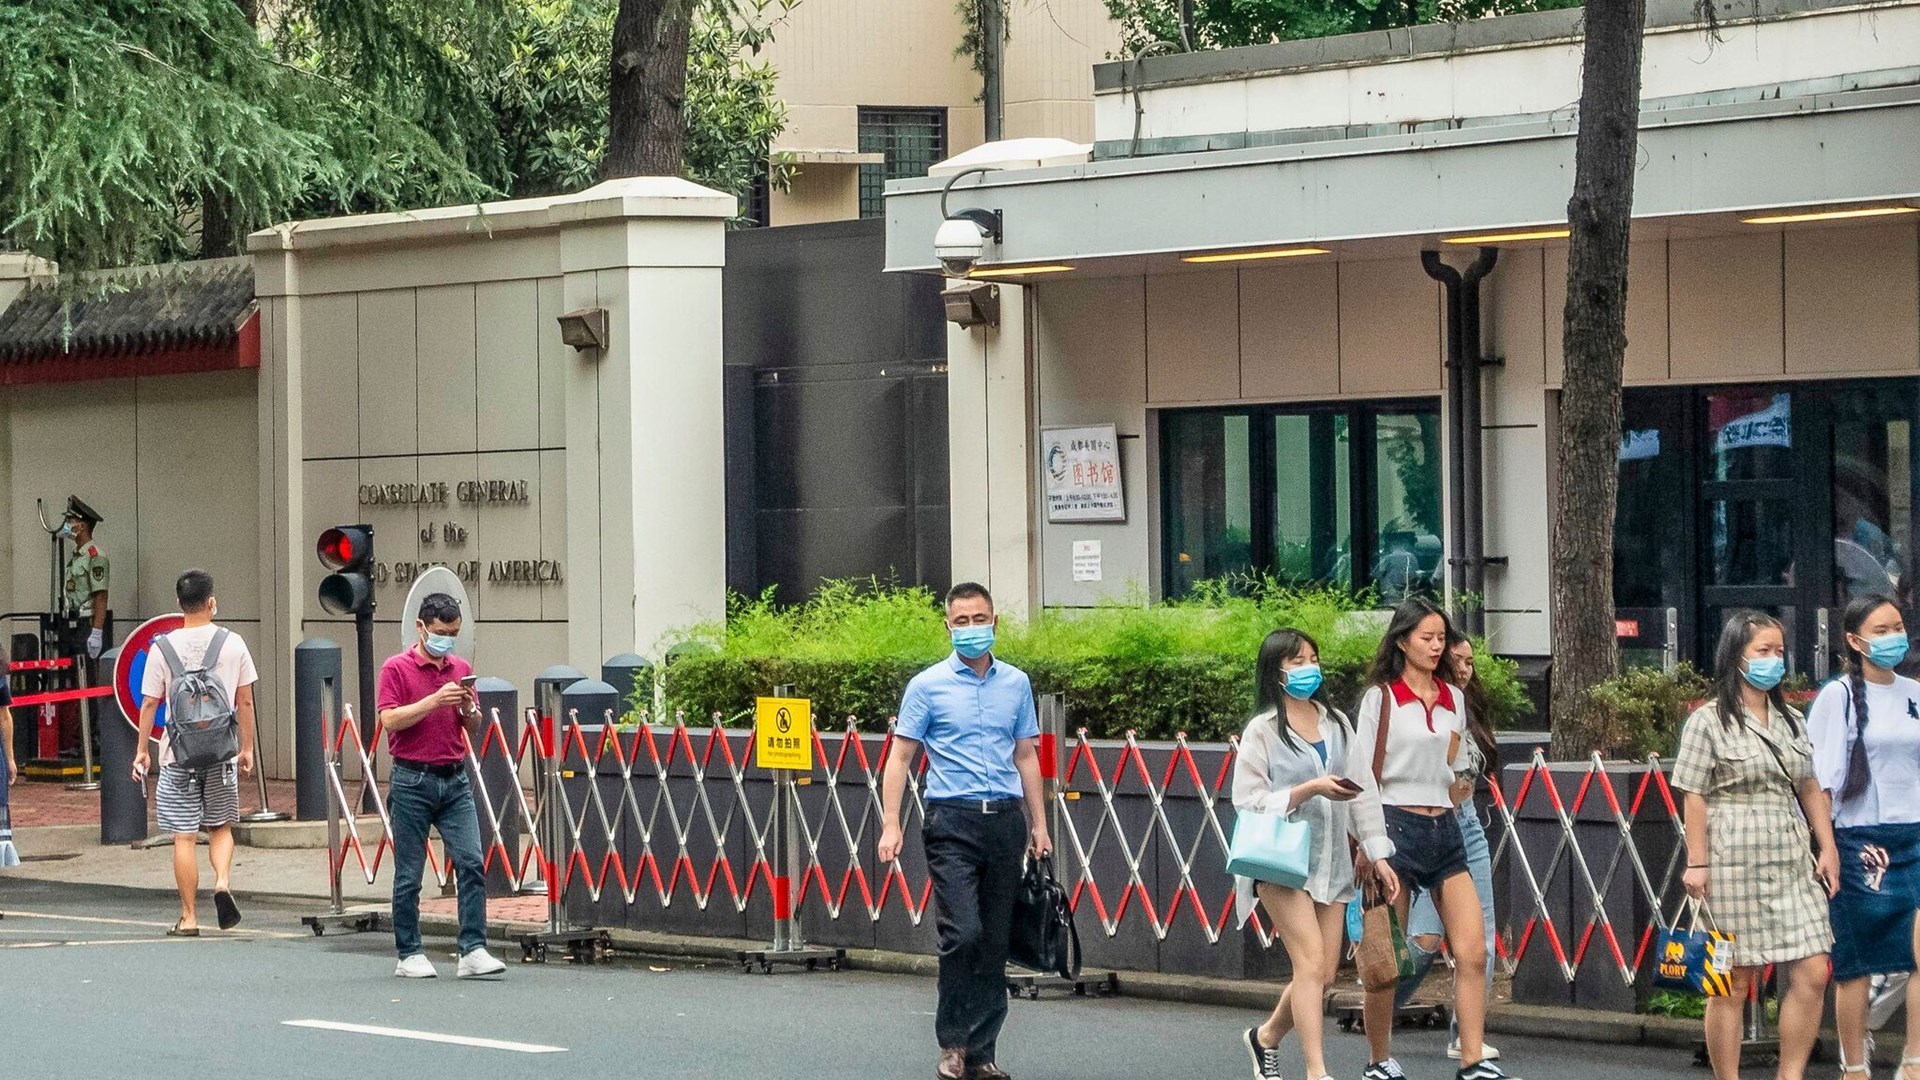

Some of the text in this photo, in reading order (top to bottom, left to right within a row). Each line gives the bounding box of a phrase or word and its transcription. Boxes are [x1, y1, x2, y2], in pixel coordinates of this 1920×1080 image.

[1072, 460, 1114, 487] 图书馆
[358, 480, 529, 505] CONSULATE GENERAL
[420, 521, 468, 543] of the
[394, 561, 448, 583] STA
[457, 560, 480, 582] OF
[487, 559, 562, 582] AMERICA
[768, 737, 800, 749] 请勿拍照
